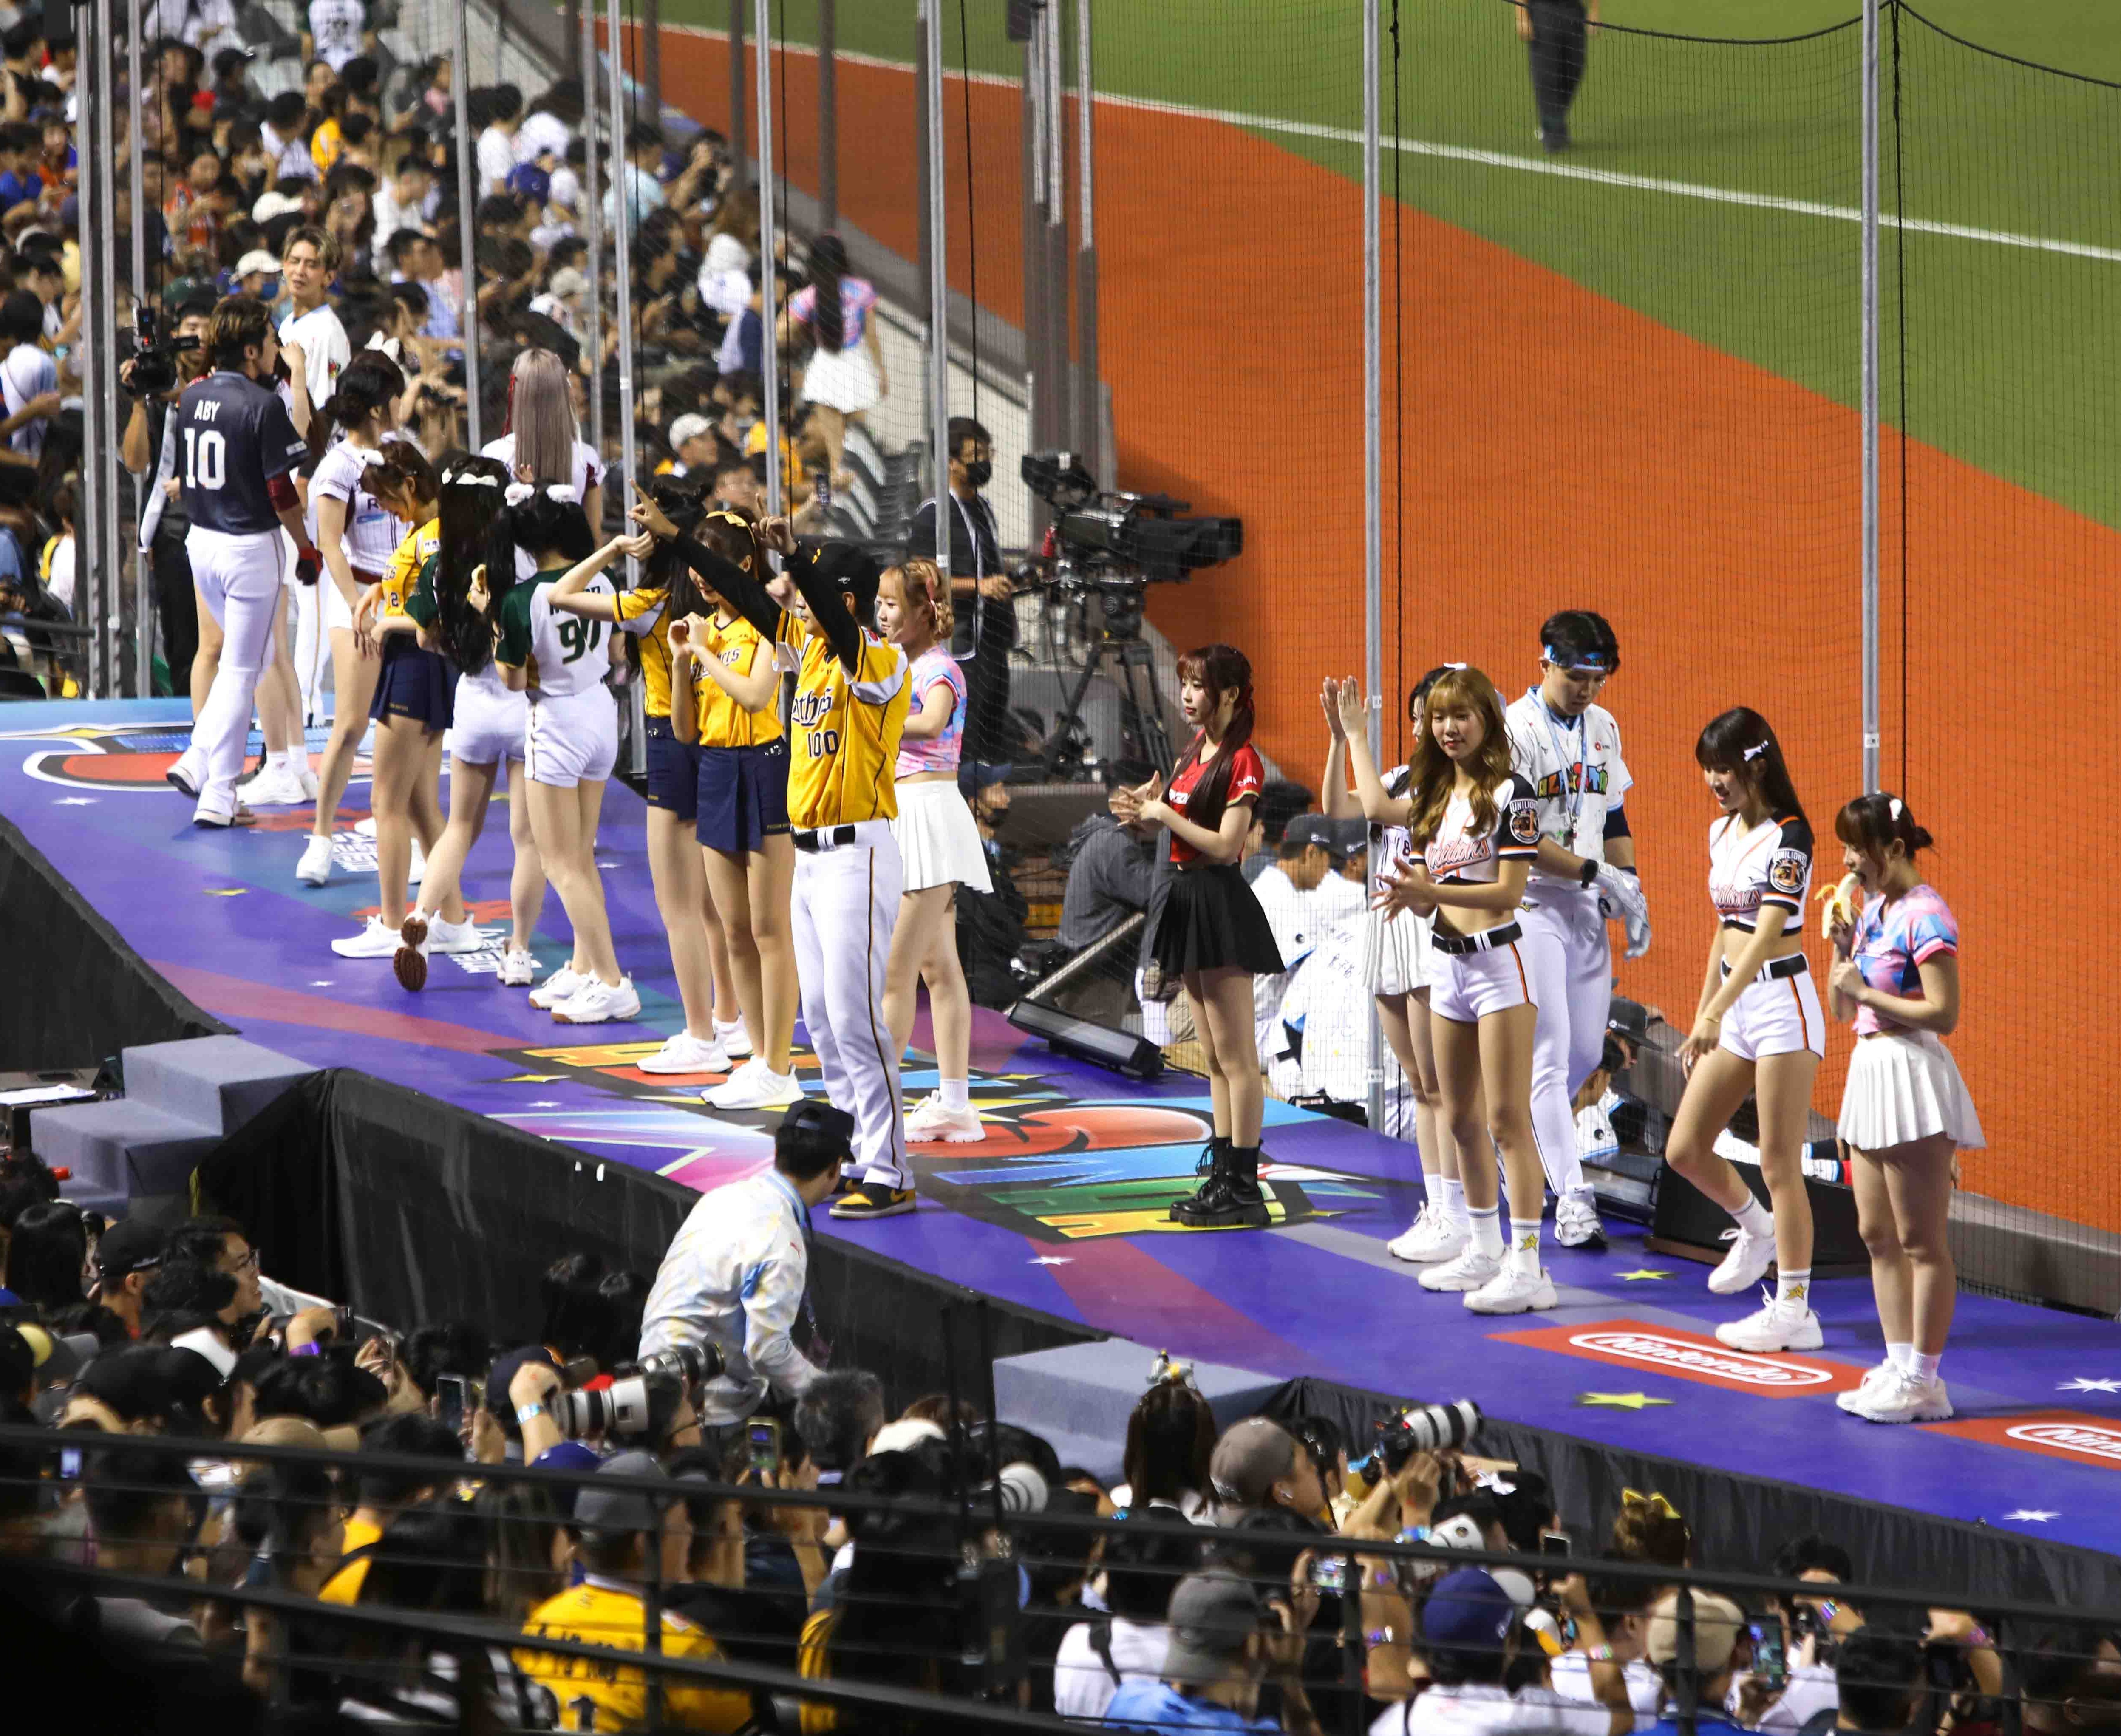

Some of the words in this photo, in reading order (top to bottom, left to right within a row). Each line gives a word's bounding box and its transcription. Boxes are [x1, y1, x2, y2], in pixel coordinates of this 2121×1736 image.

[194, 400, 221, 422] ABY
[184, 428, 225, 490] 10
[808, 730, 839, 758] 100
[1775, 850, 1807, 869] UNILIONS
[1595, 1337, 1792, 1381] Nintendo
